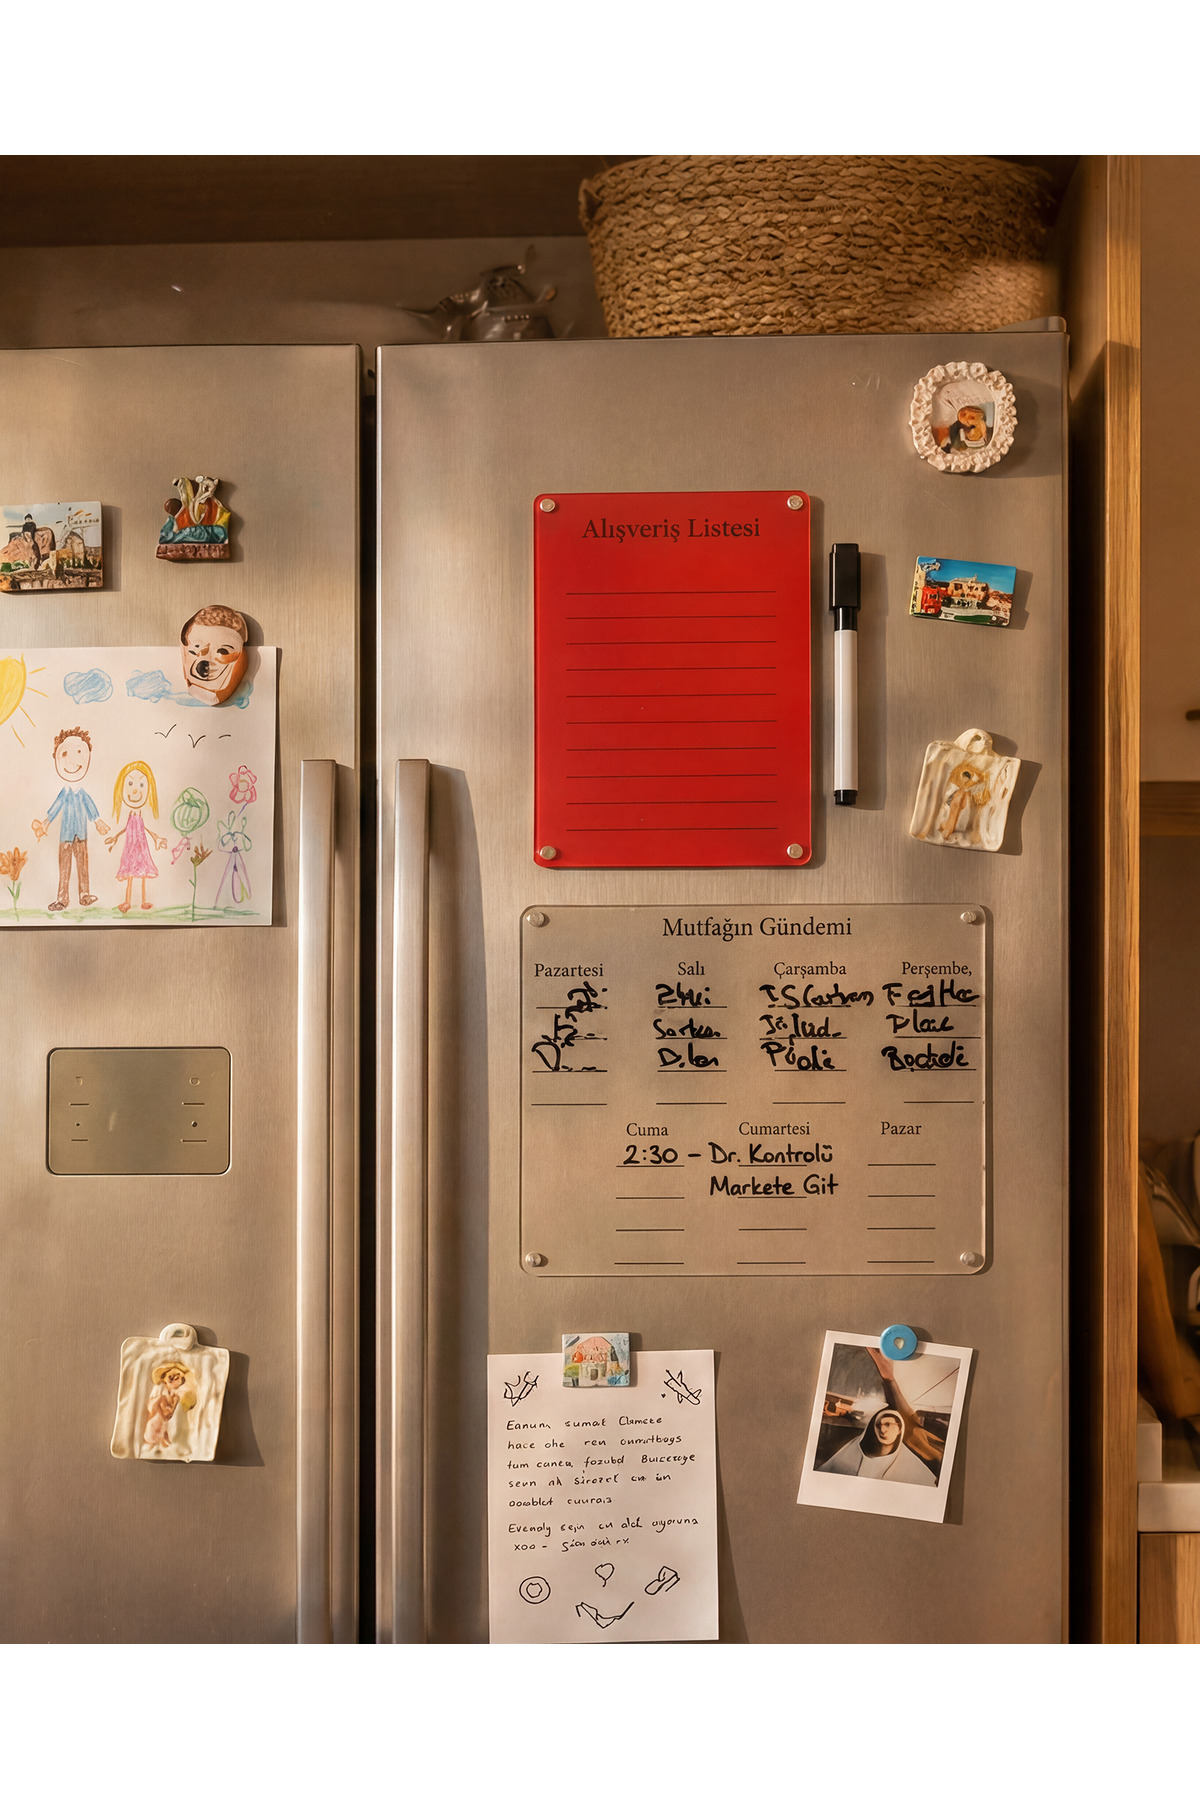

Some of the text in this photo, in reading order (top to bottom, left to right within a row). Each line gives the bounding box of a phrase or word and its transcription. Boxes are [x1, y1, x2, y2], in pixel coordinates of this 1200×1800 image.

[581, 517, 761, 544] Alışveriş Listesi
[662, 915, 853, 942] Mutfağın Gündemi
[534, 963, 604, 977] Pazartesi
[677, 961, 705, 976] Salı
[773, 960, 847, 979] Çarşamba
[901, 961, 973, 980] Perşembe,
[626, 1122, 669, 1137] Cuma
[738, 1121, 811, 1136] Cumartesi
[881, 1121, 922, 1135] Pazar
[622, 1144, 679, 1165] 2:30
[708, 1141, 741, 1164] Dr.
[709, 1173, 839, 1196] Markete Git
